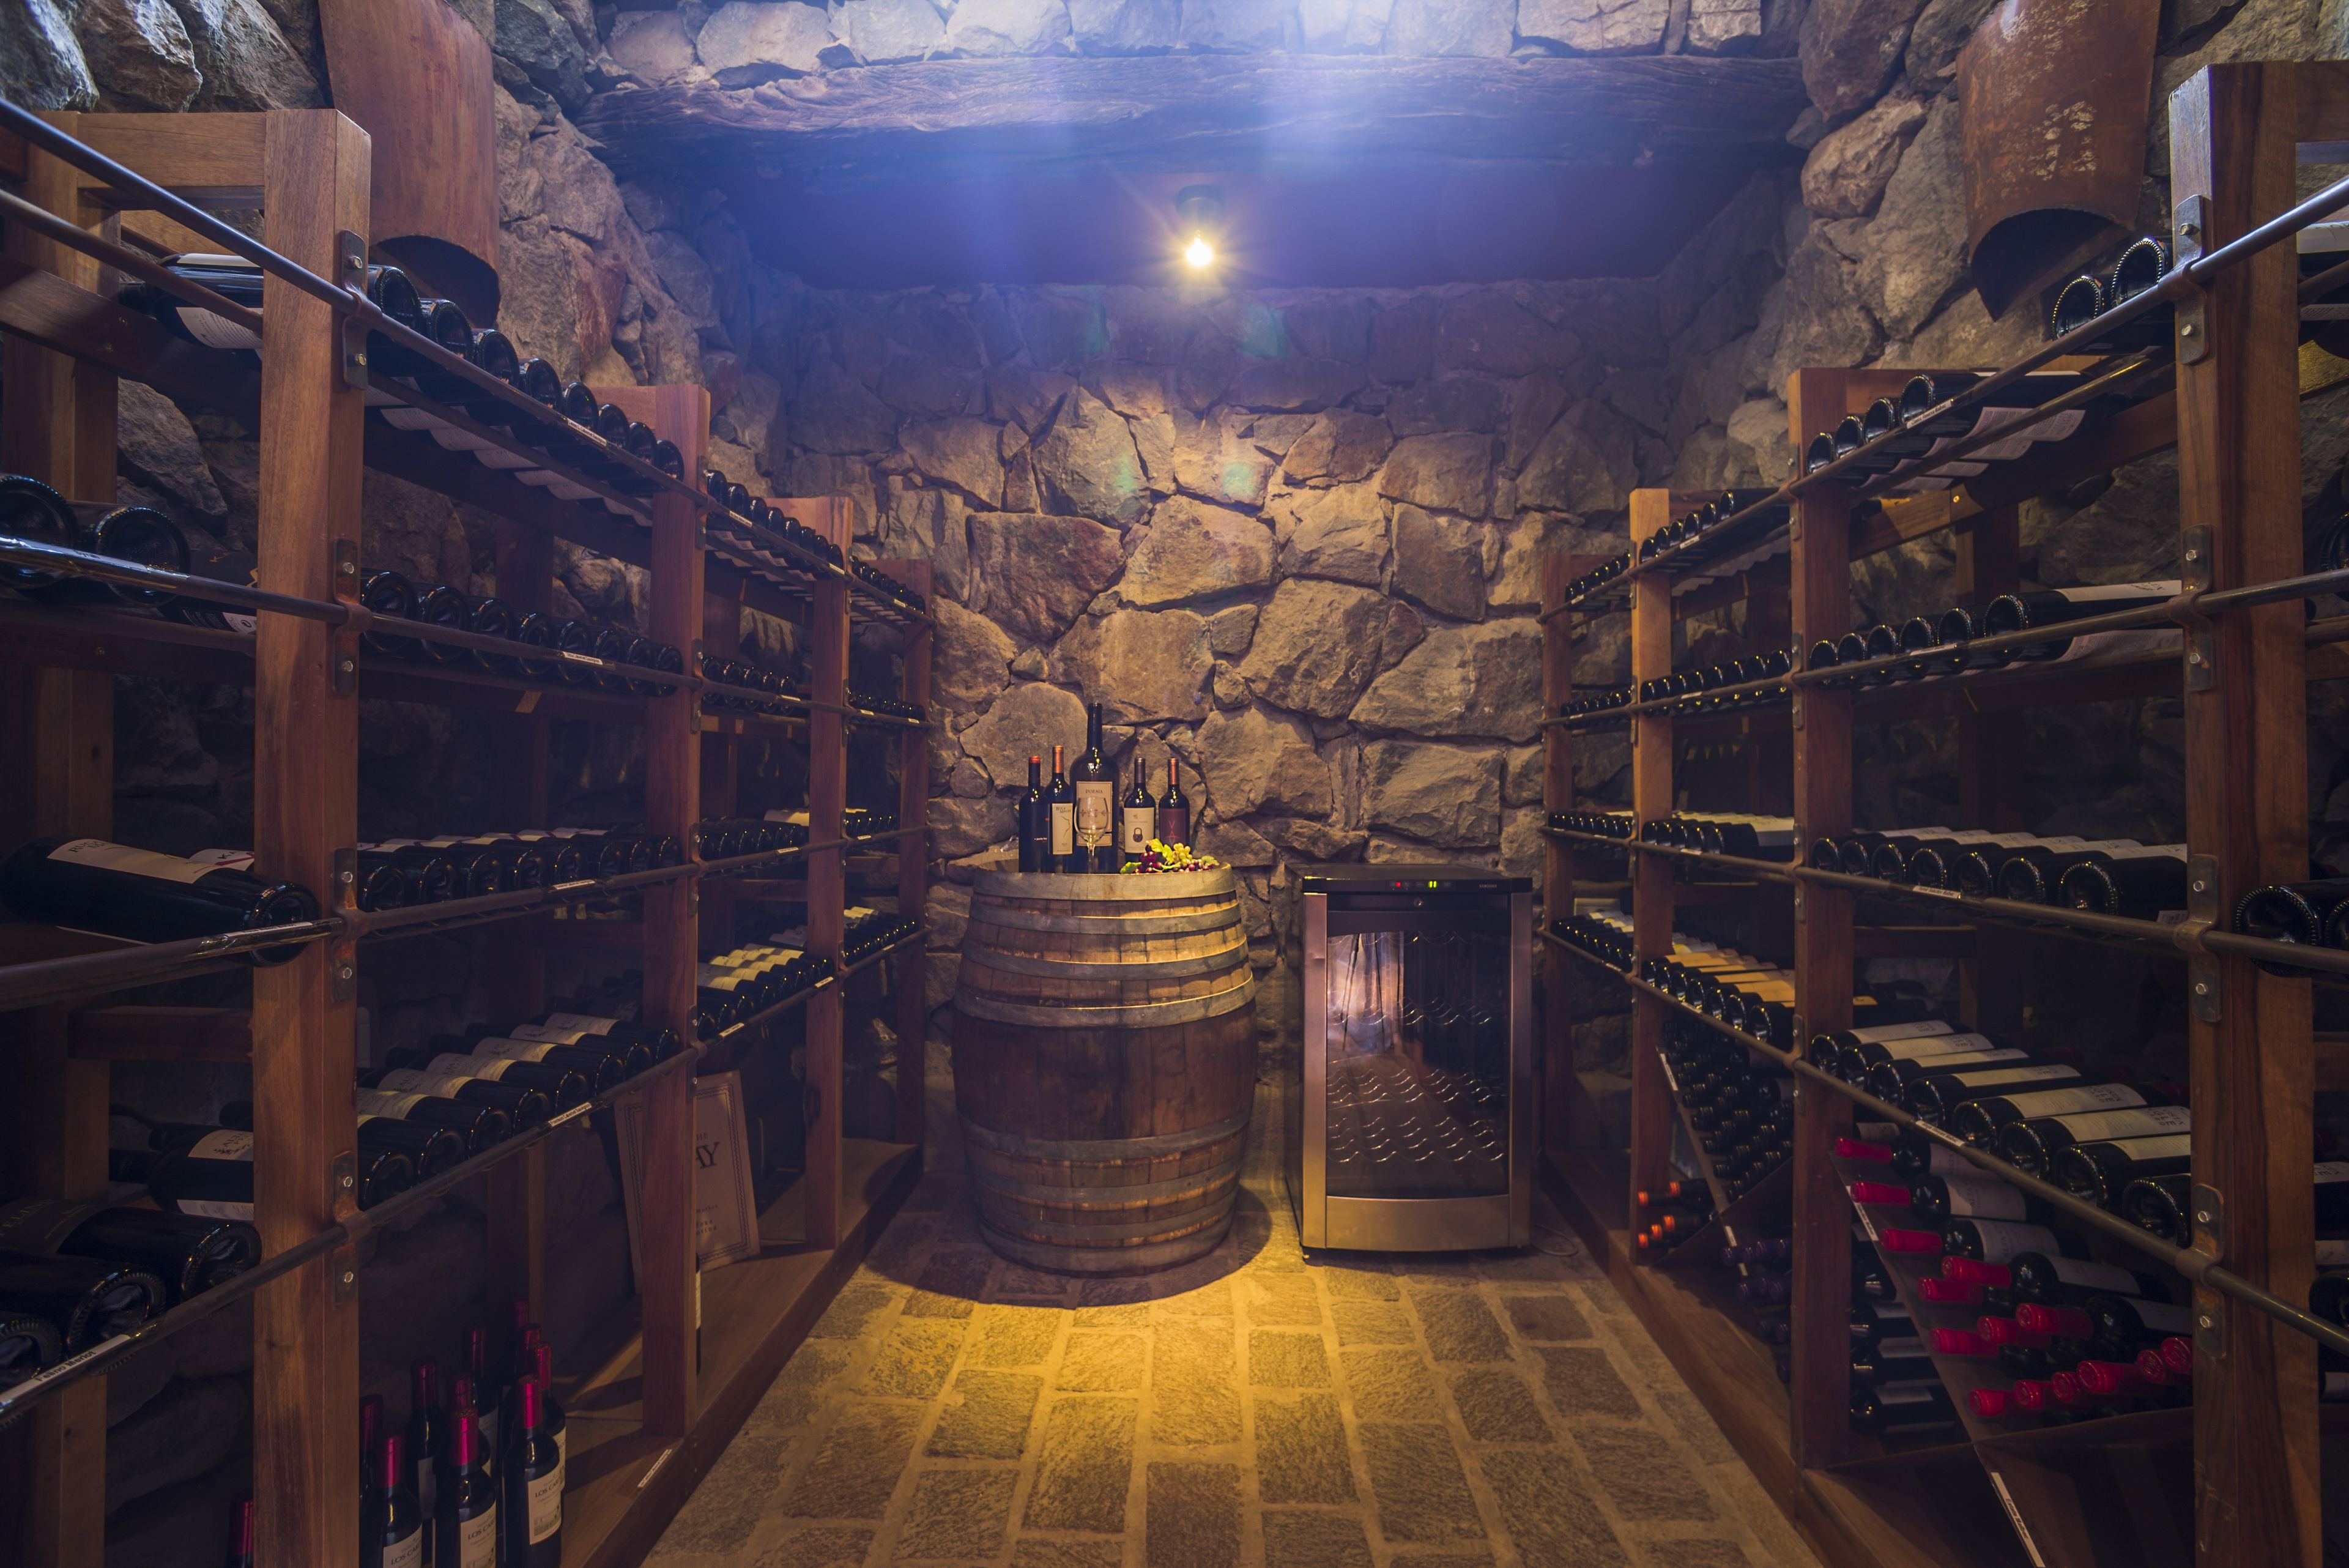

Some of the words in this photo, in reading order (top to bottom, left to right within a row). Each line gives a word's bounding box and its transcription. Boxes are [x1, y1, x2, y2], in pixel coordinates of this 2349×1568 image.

[35, 1365, 66, 1382] Felino
[65, 1350, 97, 1367] Merlot
[2005, 1498, 2017, 1517] Estate
[2015, 1517, 2028, 1539] Malbec
[468, 1530, 482, 1540] LOS
[391, 1554, 406, 1565] LOS
